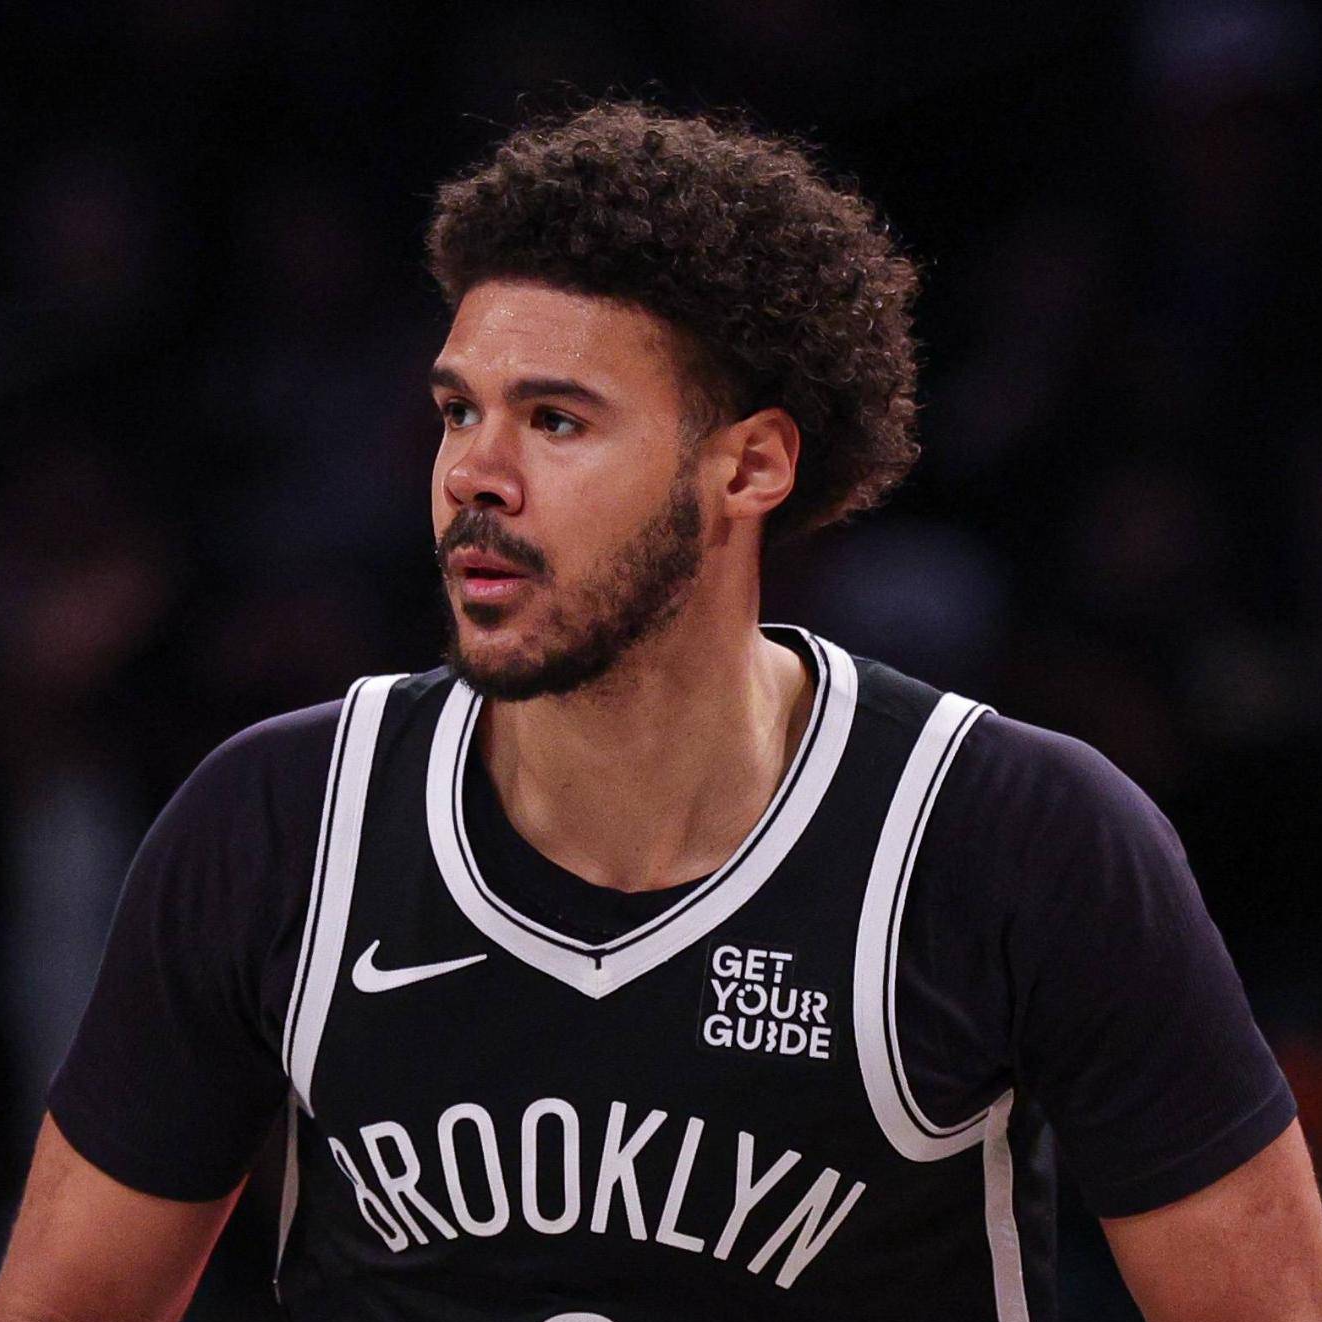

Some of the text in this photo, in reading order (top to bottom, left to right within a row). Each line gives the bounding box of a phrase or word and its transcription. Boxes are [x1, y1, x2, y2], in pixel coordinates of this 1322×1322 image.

[712, 945, 793, 984] GET
[711, 979, 829, 1024] YOUR
[704, 1013, 832, 1060] GUIDE
[328, 1097, 866, 1290] BROOKLYN
